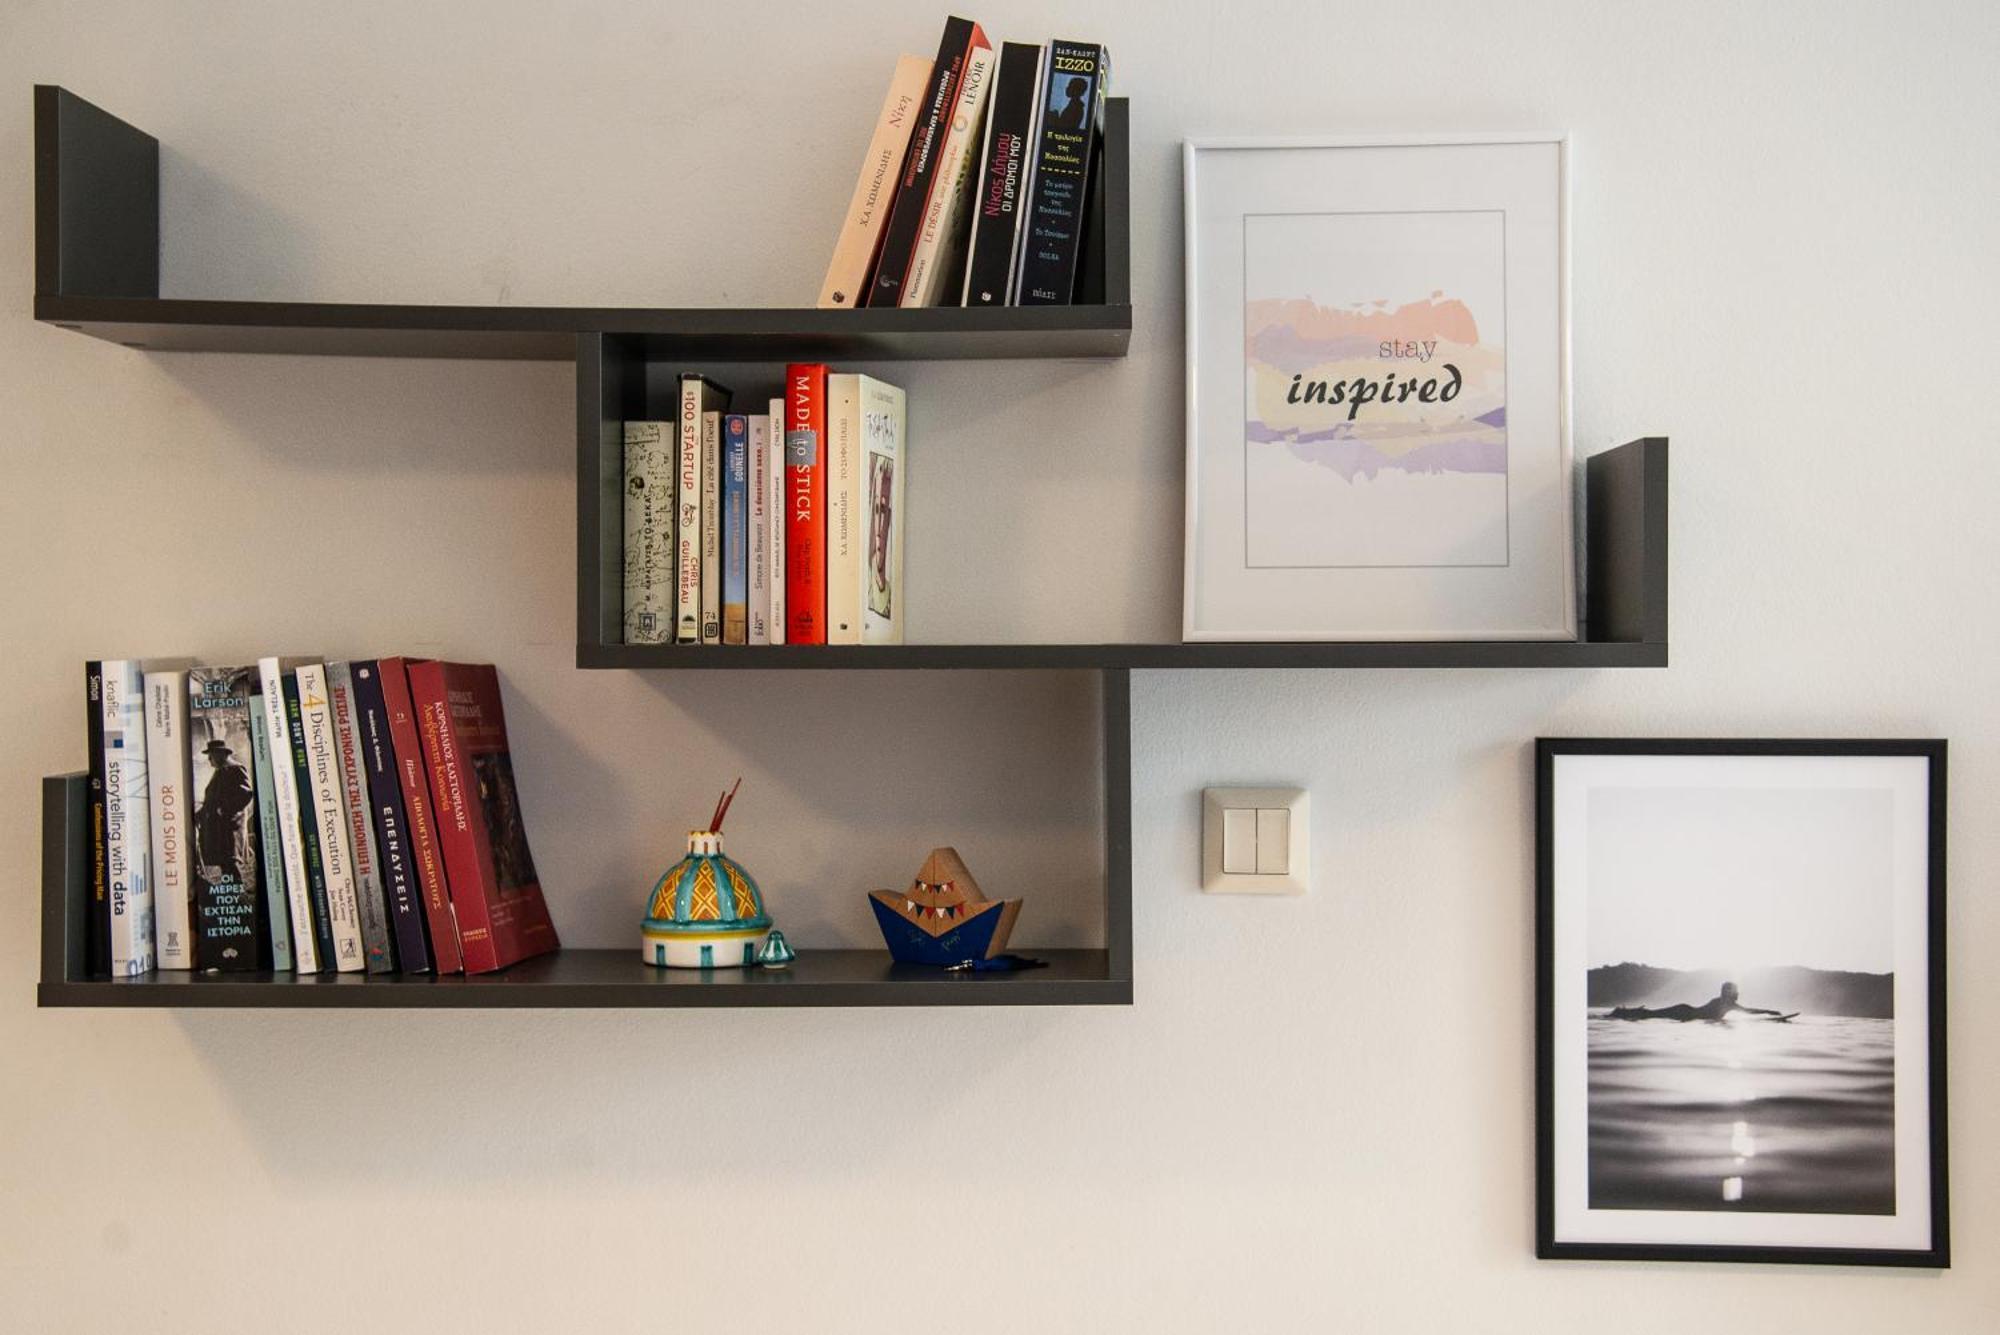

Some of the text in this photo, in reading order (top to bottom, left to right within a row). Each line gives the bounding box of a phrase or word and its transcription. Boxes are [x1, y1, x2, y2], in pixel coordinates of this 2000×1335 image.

[964, 61, 984, 104] LENOIR
[1002, 134, 1022, 212] ΟΙ ΔΡΟΜΟΙ ΜΟΥ
[1379, 337, 1437, 363] stay
[1287, 363, 1462, 421] inspired
[682, 425, 694, 489] STARTUP
[795, 376, 810, 520] MADE to STICK
[680, 540, 690, 603] GUILLEBEAU
[689, 556, 697, 587] CHRIS
[89, 675, 100, 701] Simon
[194, 696, 244, 709] Larson
[204, 681, 232, 694] Erik
[333, 685, 349, 724] ΡΩΣΙΑΣ
[302, 672, 343, 875] The 4 Disciplines of Execution
[339, 726, 358, 786] ΣΥΓΧΡΟΝΗΣ
[434, 701, 466, 830] ΚΟΡΝΗΛΙΟΣ ΚΑΣΤΟΡΙΑΔΗΣ
[348, 788, 361, 807] ΤΗΣ
[103, 761, 127, 915] storytelling with data
[161, 785, 177, 886] LE MOIS D'OR
[351, 810, 369, 864] ΕΠΙΝΟΗΣΗ
[413, 796, 440, 909] ΑΠΟΛΟΓΙΑ ΣΩΚΡΑΤΟΥΣ
[220, 874, 234, 884] ΟΙ
[359, 866, 371, 875] Η
[383, 806, 408, 912] ΕΠΕΝΔΥΣΕΙΣ
[208, 883, 245, 896] ΜΕΡΕΣ
[216, 895, 240, 905] ΠΟΥ
[204, 904, 253, 917] ΕΧΤΙΣΑΝ
[217, 916, 241, 926] ΤΗΝ
[207, 925, 252, 938] ΙΣΤΟΡΙΑ
